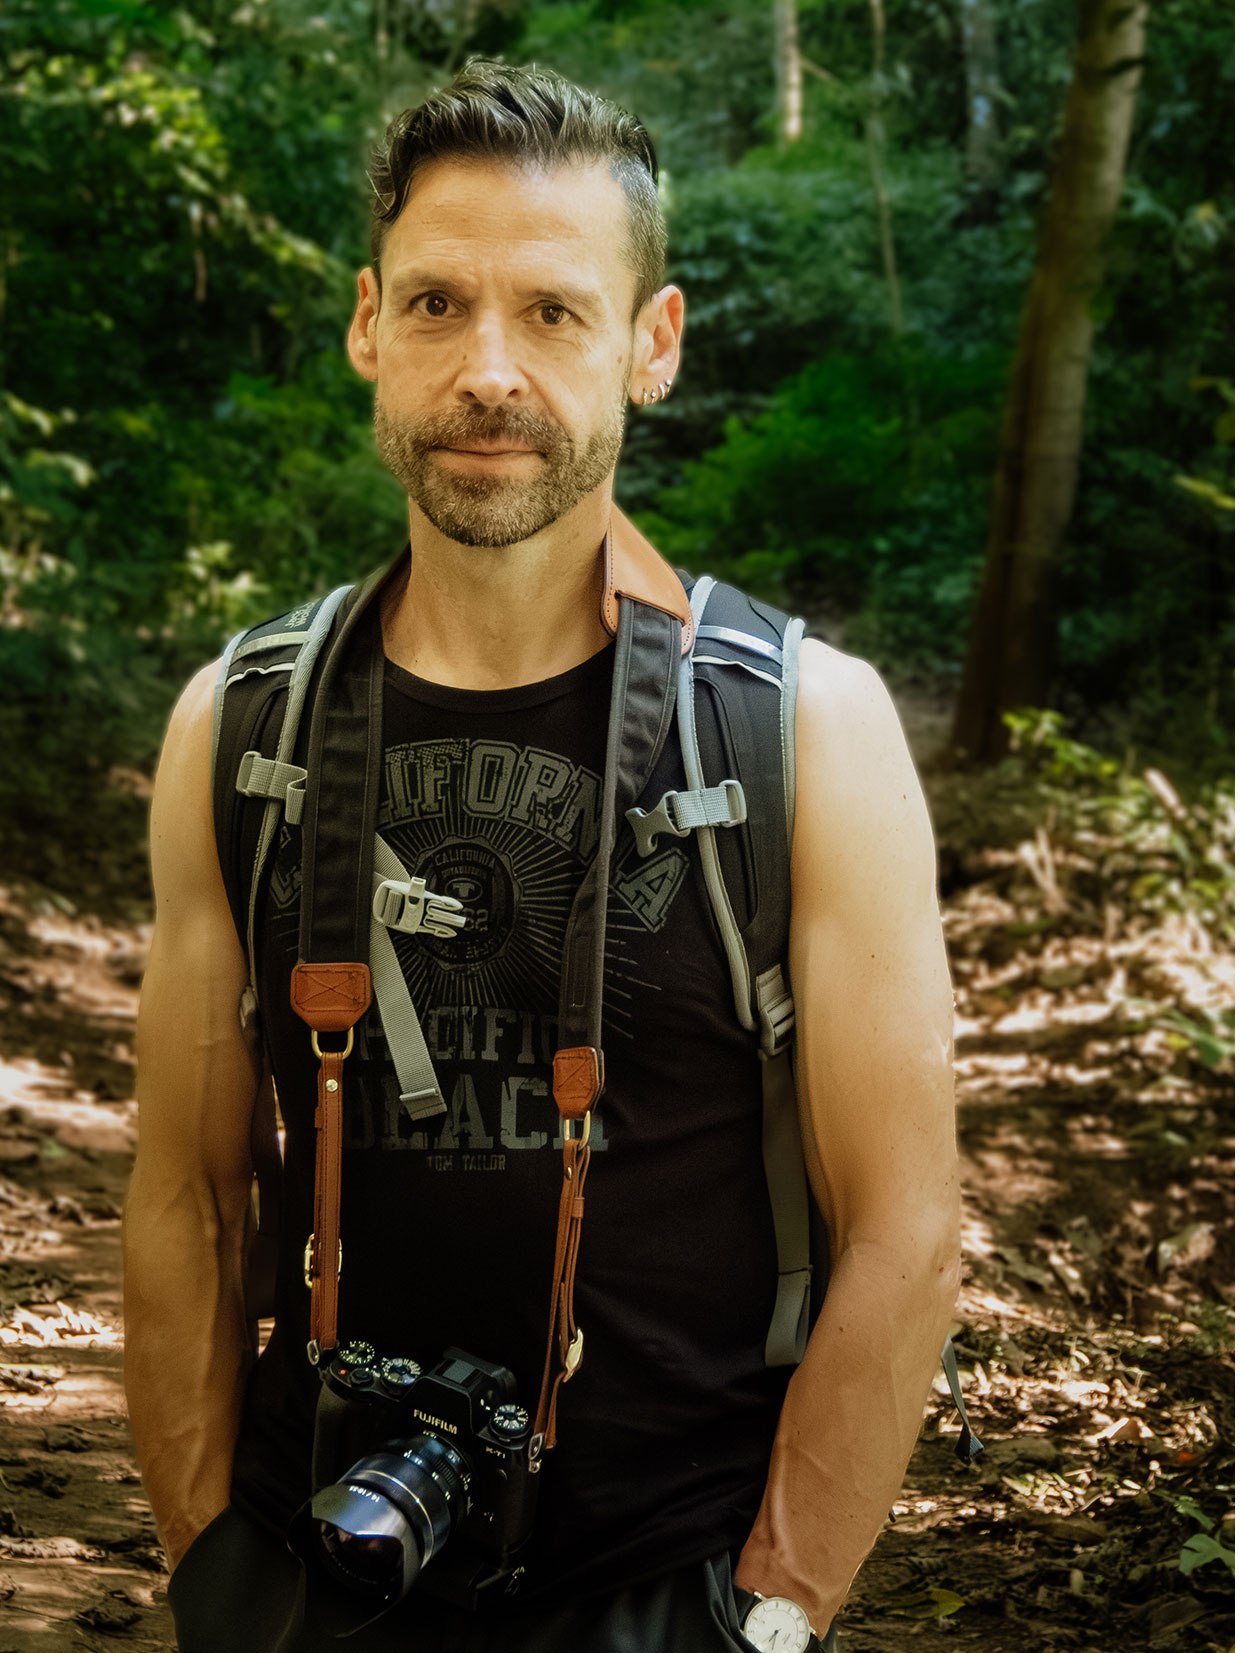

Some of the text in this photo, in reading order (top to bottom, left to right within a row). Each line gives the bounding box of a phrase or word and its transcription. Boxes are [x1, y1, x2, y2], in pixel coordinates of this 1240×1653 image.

[425, 1153, 507, 1172] TOM TAILOR
[413, 1408, 458, 1435] FUJIFILM
